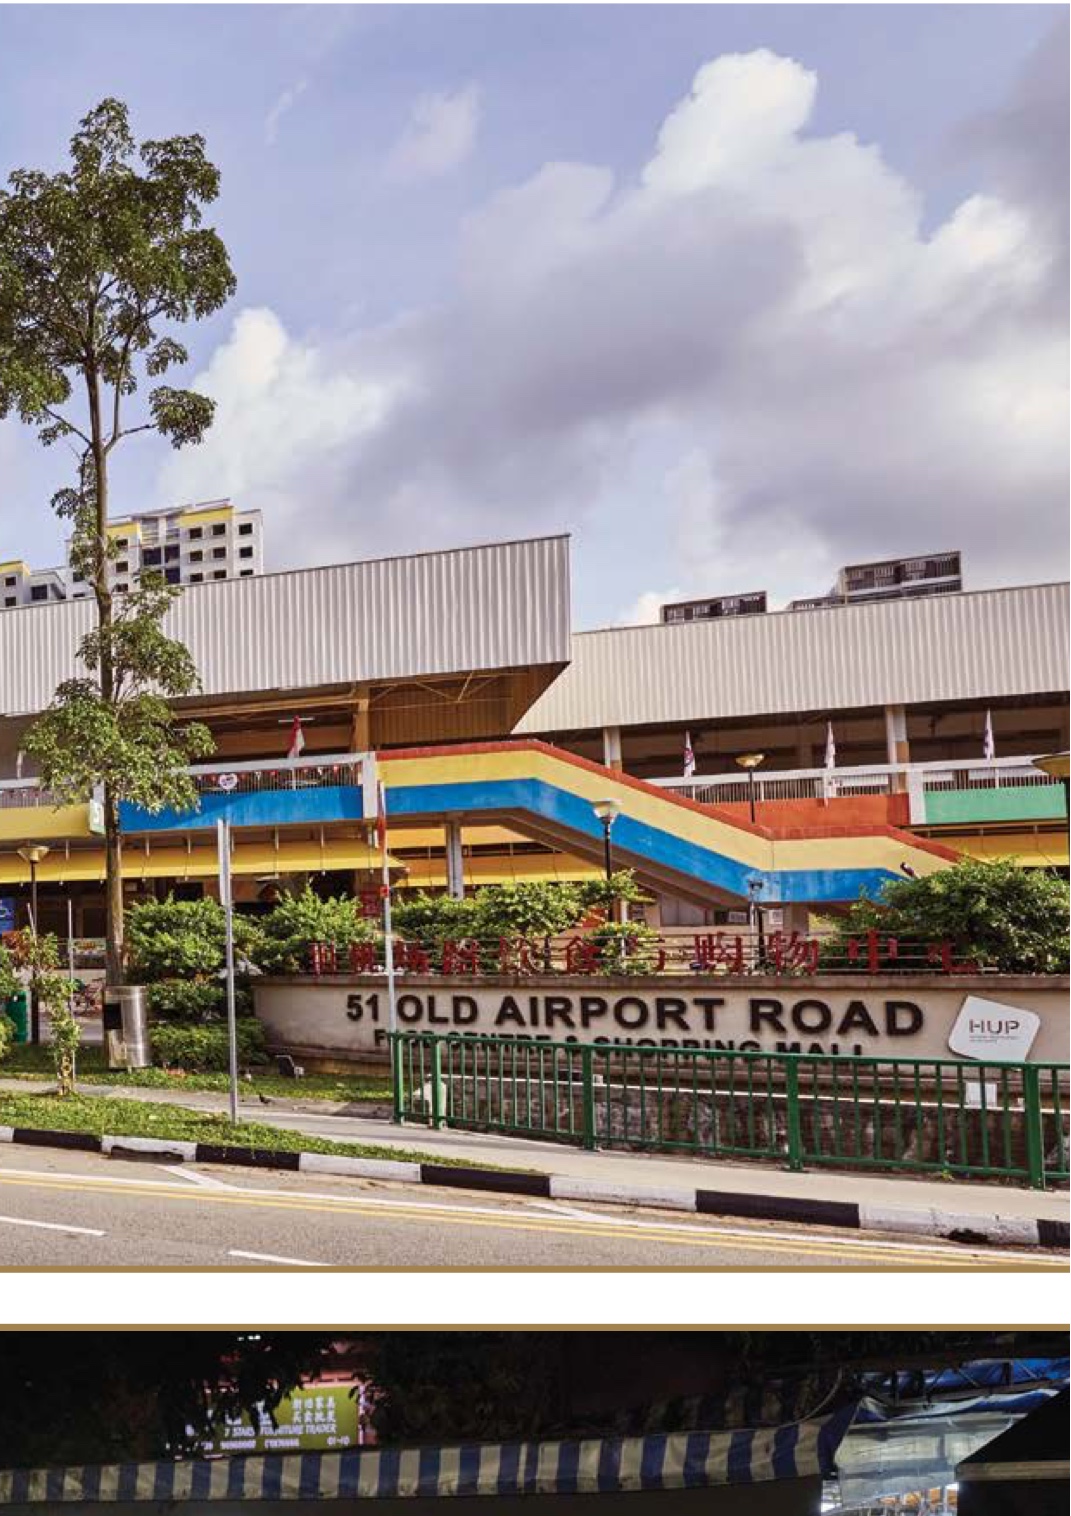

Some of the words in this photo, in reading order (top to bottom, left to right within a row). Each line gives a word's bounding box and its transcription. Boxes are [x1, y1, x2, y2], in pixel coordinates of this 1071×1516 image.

[346, 994, 379, 1021] 51
[396, 994, 479, 1024] OLD
[494, 995, 725, 1032] AIRPORT
[749, 998, 925, 1037] ROAD
[968, 1018, 1021, 1035] HUP
